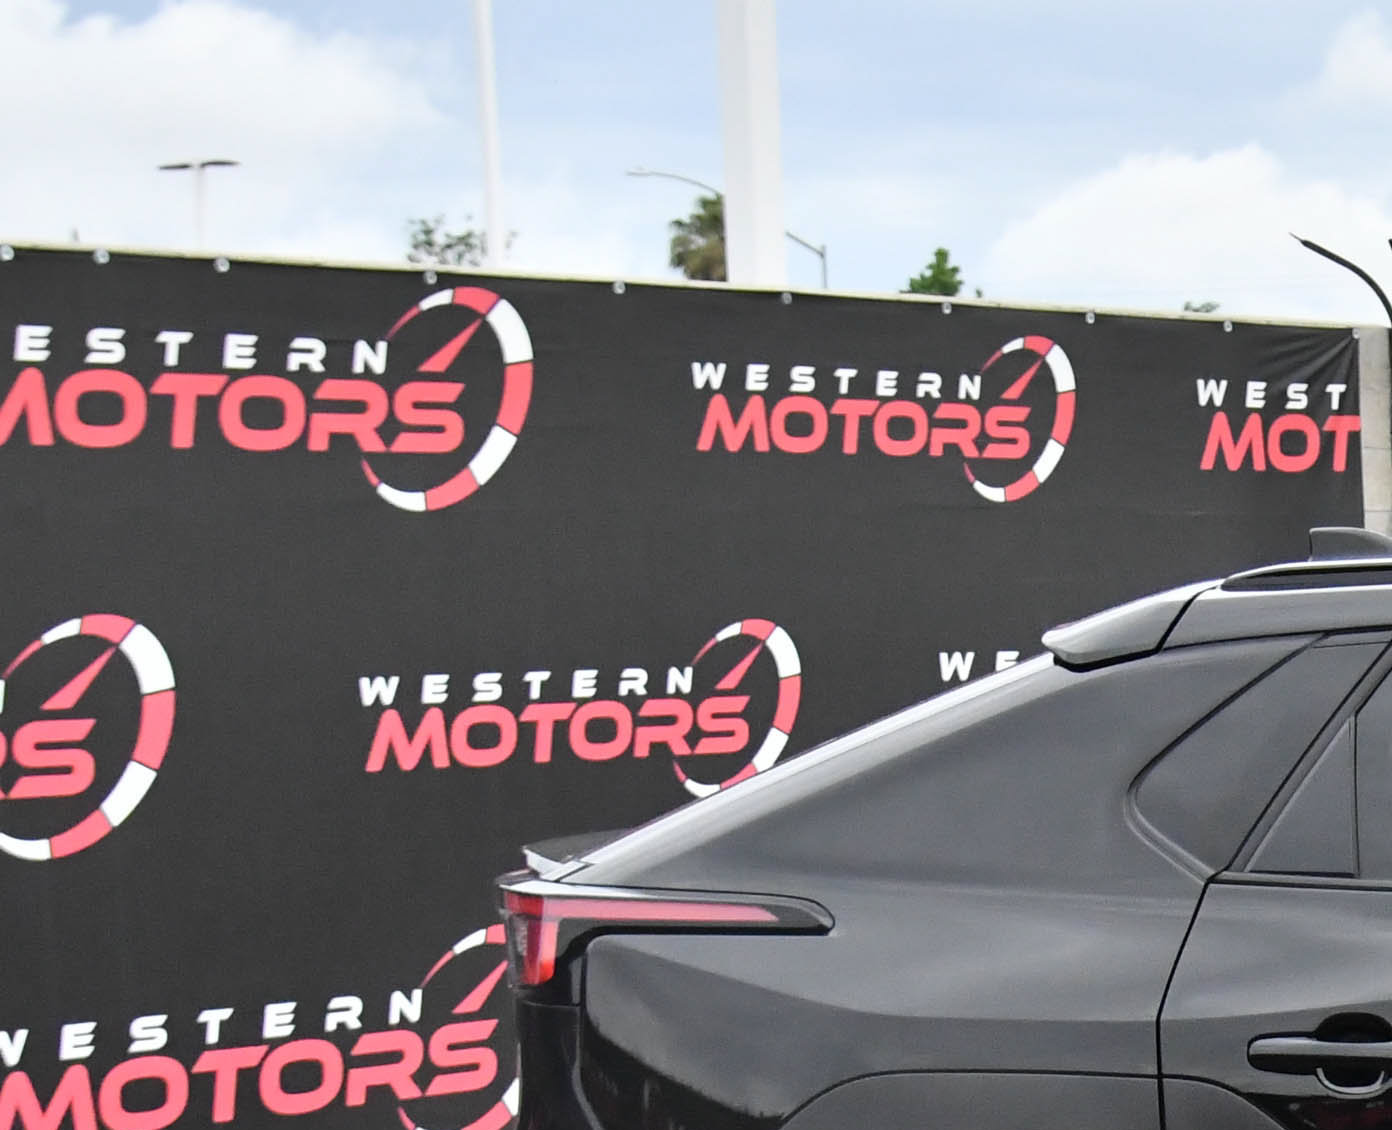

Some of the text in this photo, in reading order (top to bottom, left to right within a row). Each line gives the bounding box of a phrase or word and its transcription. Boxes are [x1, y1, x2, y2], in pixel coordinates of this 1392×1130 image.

[13, 324, 388, 375] ESTERN
[690, 361, 982, 401] WESTERN
[1196, 378, 1347, 411] WEST
[696, 393, 1031, 460] MOTORS
[1199, 411, 1362, 473] MOT
[358, 666, 694, 707] WESTERN
[365, 695, 750, 773] MOTORS
[0, 988, 423, 1068] WESTERN
